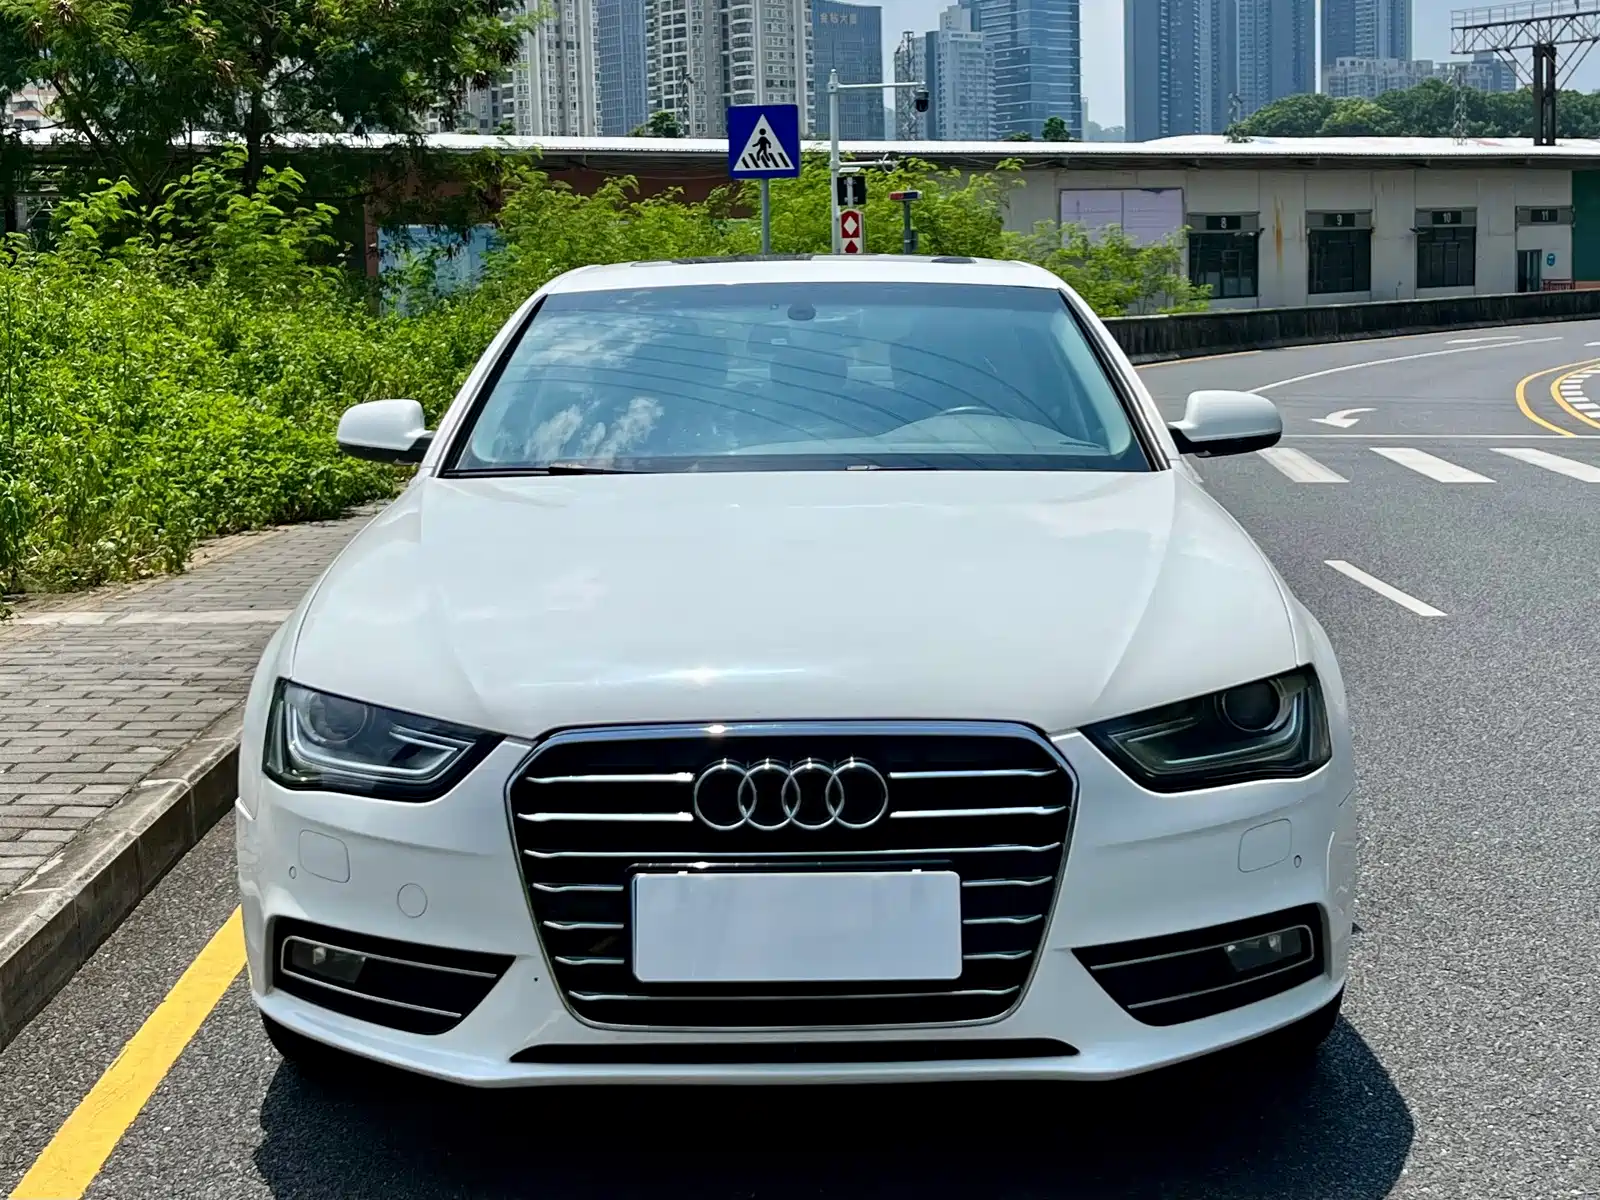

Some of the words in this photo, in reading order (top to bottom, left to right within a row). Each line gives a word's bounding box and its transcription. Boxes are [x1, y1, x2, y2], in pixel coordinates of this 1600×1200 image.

[1336, 214, 1343, 226] 9
[1442, 212, 1452, 223] 10
[1541, 210, 1549, 221] 11
[1220, 217, 1227, 229] 8
